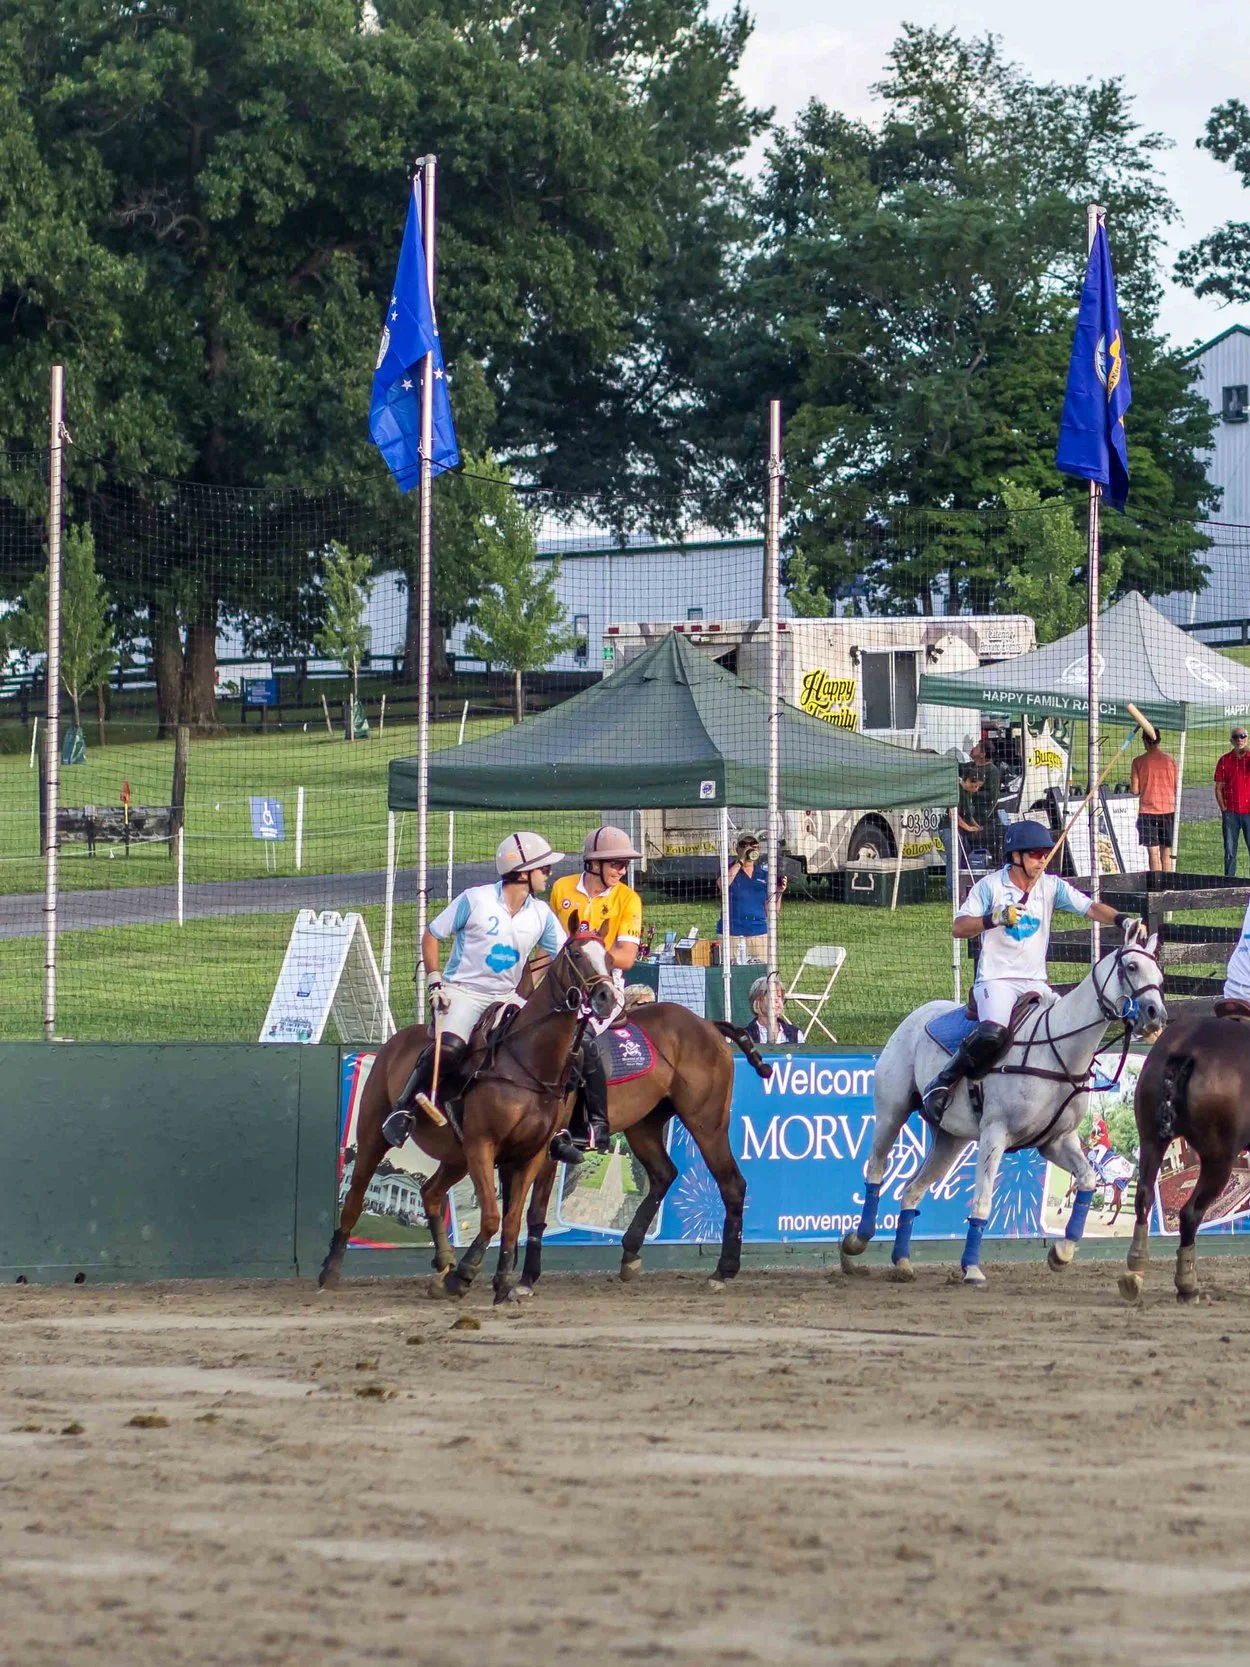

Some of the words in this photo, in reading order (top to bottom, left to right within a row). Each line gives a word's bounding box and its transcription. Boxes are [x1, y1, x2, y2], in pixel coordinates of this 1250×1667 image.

[801, 670, 855, 705] Happy
[983, 690, 1023, 704] HAPPY
[1026, 694, 1070, 709] FAMILY
[1072, 699, 1117, 715] RACH
[1224, 703, 1249, 717] HAPPY
[486, 916, 499, 936] 2
[763, 1061, 875, 1096] Welcom
[740, 1115, 927, 1160] MORVN
